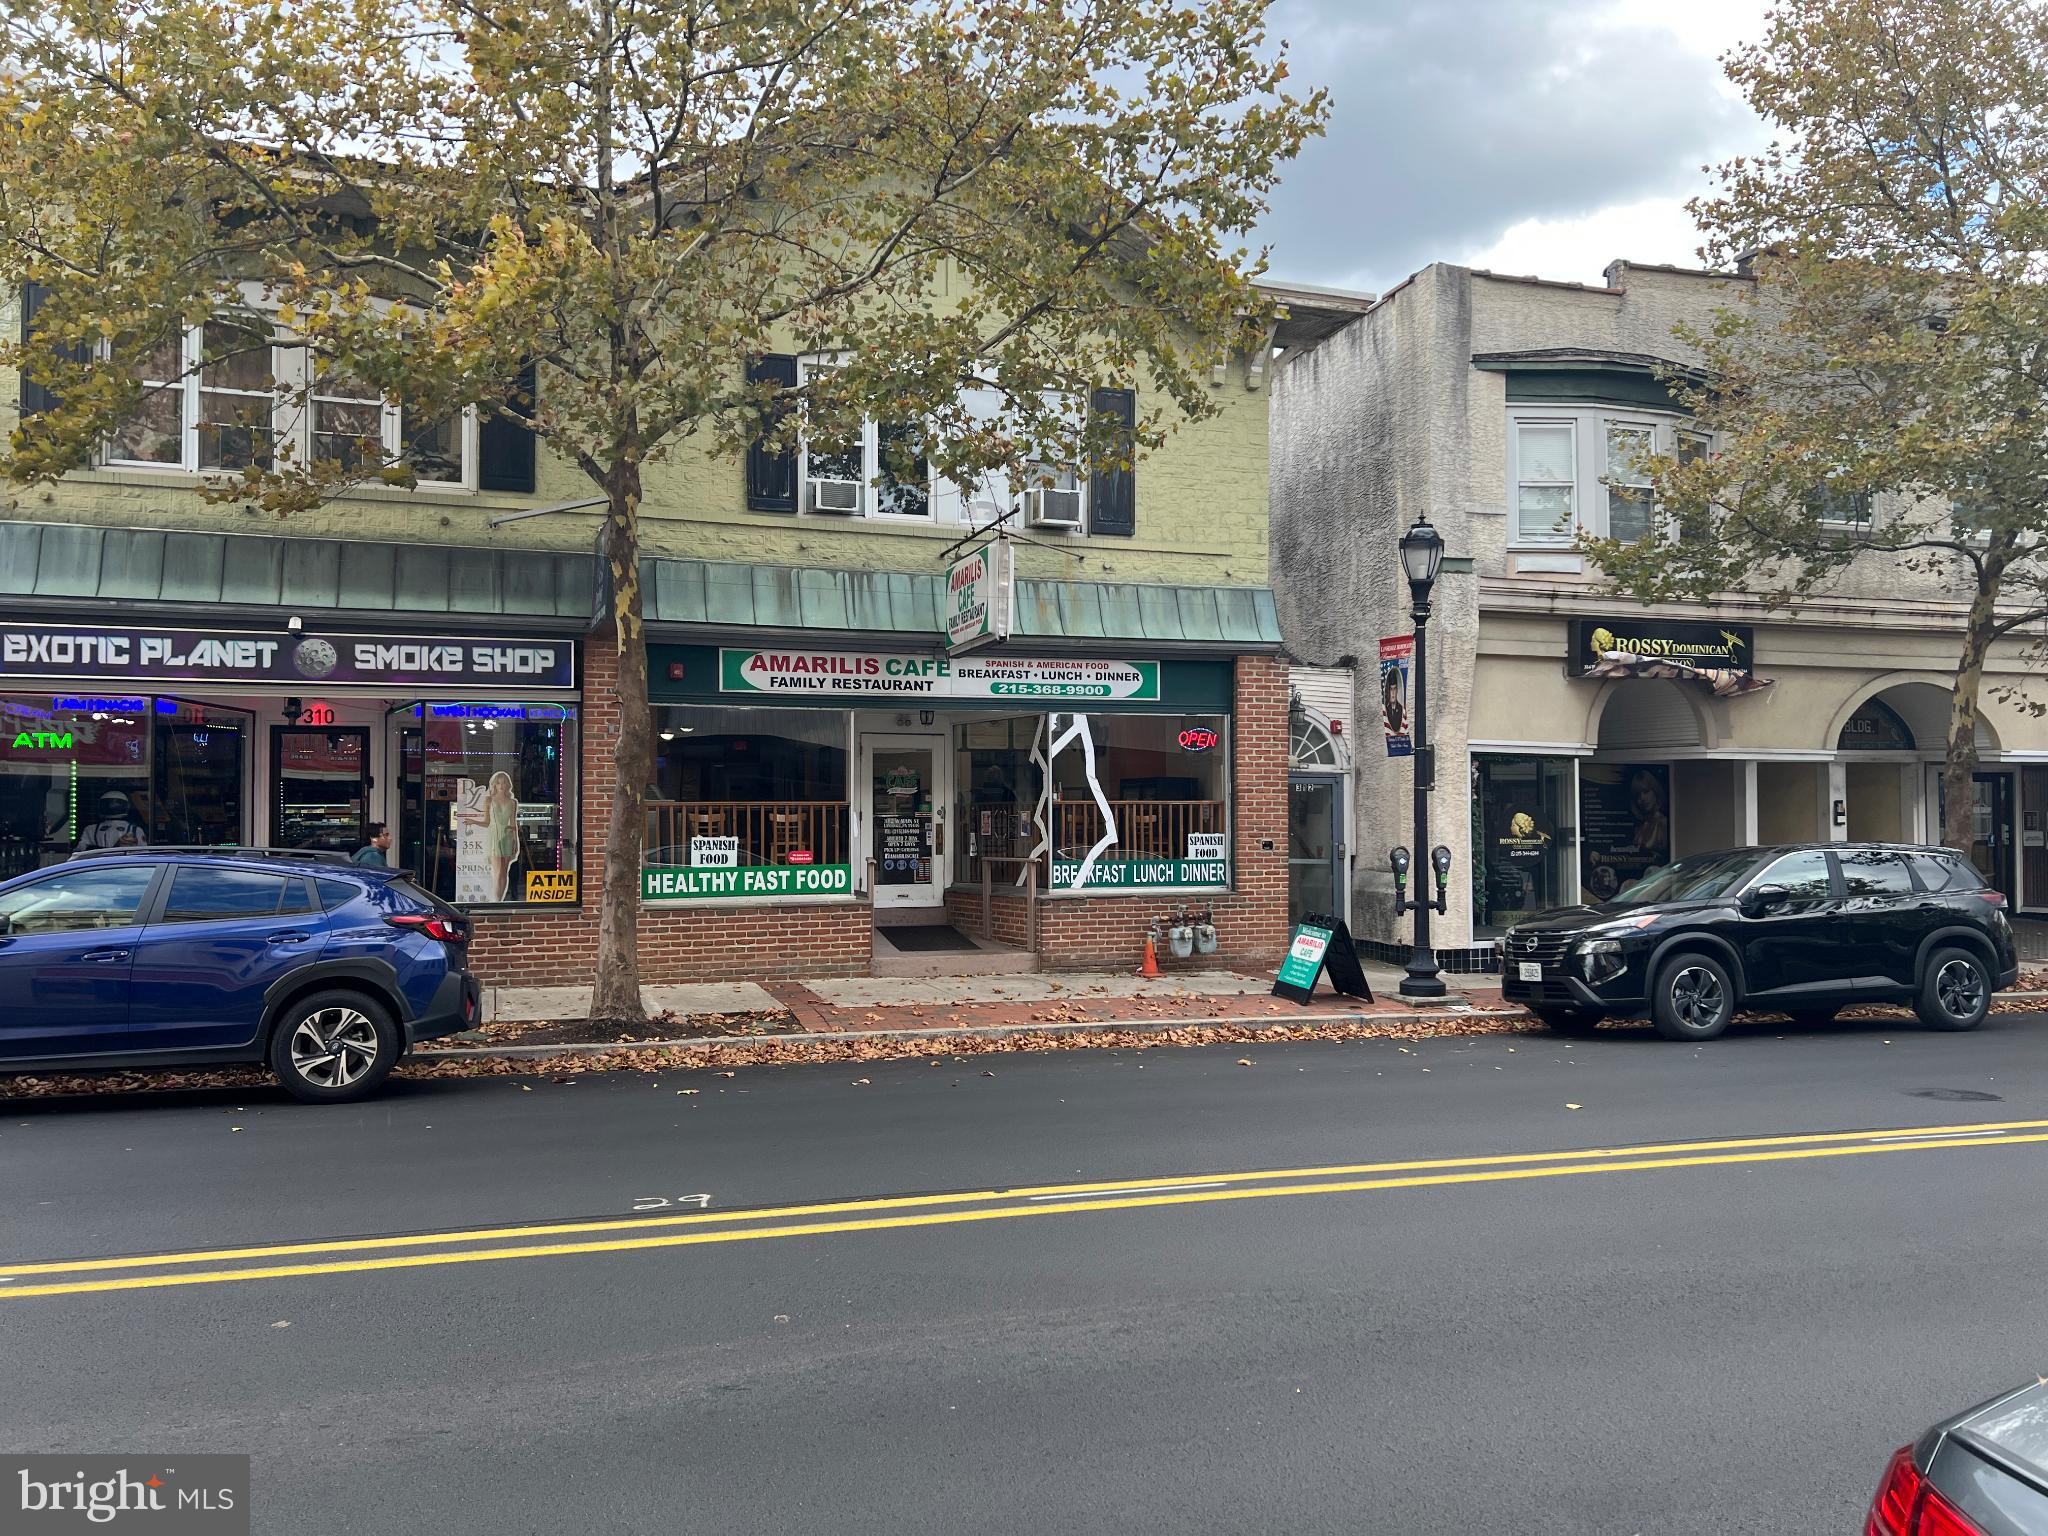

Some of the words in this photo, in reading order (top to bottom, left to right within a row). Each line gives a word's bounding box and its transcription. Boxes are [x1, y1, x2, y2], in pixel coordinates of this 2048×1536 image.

[951, 559, 982, 593] AMARILIS
[959, 583, 975, 612] CAFE
[1616, 638, 1673, 656] ROSSY
[1672, 643, 1729, 655] DOMINICAN
[3, 634, 130, 665] EXOTIC
[140, 637, 278, 668] PLANET
[354, 644, 463, 672] SMOKE
[472, 647, 555, 674] SHOP
[750, 655, 880, 675] AMARILIS
[886, 658, 951, 677] CAFE
[985, 660, 1024, 668] SPANISH
[1036, 661, 1083, 669] AMERICAN
[1085, 662, 1109, 670] FOOD
[958, 669, 1031, 680] BREAKFAST
[1041, 670, 1082, 681] LUNCH
[1095, 671, 1140, 682] DINNER
[770, 676, 827, 689] FAMILY
[832, 677, 934, 691] RESTAURANT
[998, 683, 1104, 695] 215-368-9900
[303, 709, 335, 724] 310
[13, 732, 72, 749] ATM
[1178, 731, 1217, 747] OPEN
[462, 841, 483, 850] 35K
[693, 839, 735, 851] SPANISH
[1189, 836, 1224, 846] SPANISH
[699, 853, 729, 865] FOOD
[1195, 848, 1218, 858] FOOD
[457, 864, 492, 872] SPRING
[1053, 865, 1126, 883] BREKFAST
[1134, 864, 1174, 882] LUNCH
[1181, 863, 1225, 882] DINNER
[531, 874, 574, 887] ATM
[647, 872, 738, 894] HEALTHY
[744, 870, 790, 891] FAST
[796, 869, 847, 889] FOOD
[529, 889, 573, 900] INSIDE
[1297, 937, 1324, 949] AMARILIS
